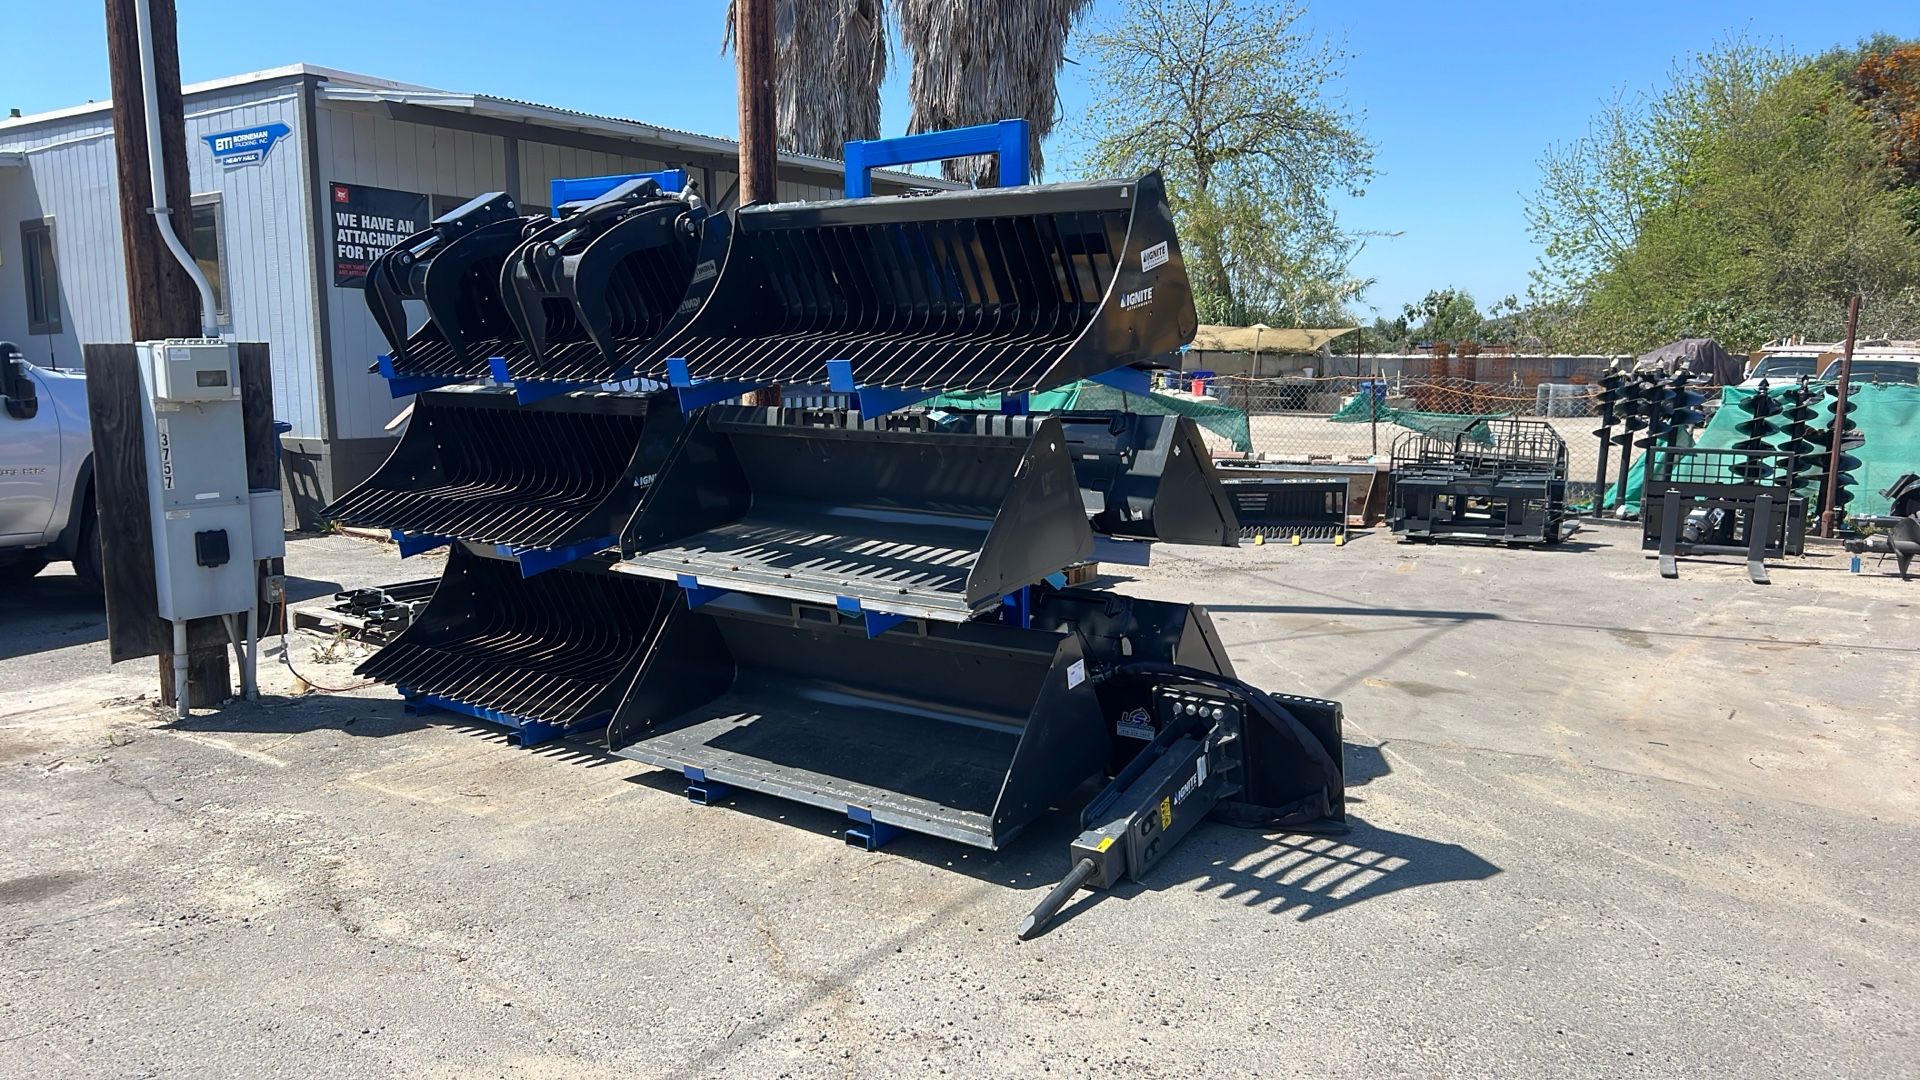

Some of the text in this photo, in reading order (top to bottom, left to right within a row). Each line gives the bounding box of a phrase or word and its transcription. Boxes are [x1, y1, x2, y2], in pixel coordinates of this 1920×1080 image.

[234, 131, 268, 142] BORNEMAN
[336, 212, 415, 234] WE HAVE AN
[336, 228, 409, 247] ATTACHME
[337, 244, 388, 261] FOR TH
[1127, 287, 1153, 306] IGNITE
[160, 433, 173, 489] 3757
[1178, 772, 1197, 800] IGNITE
